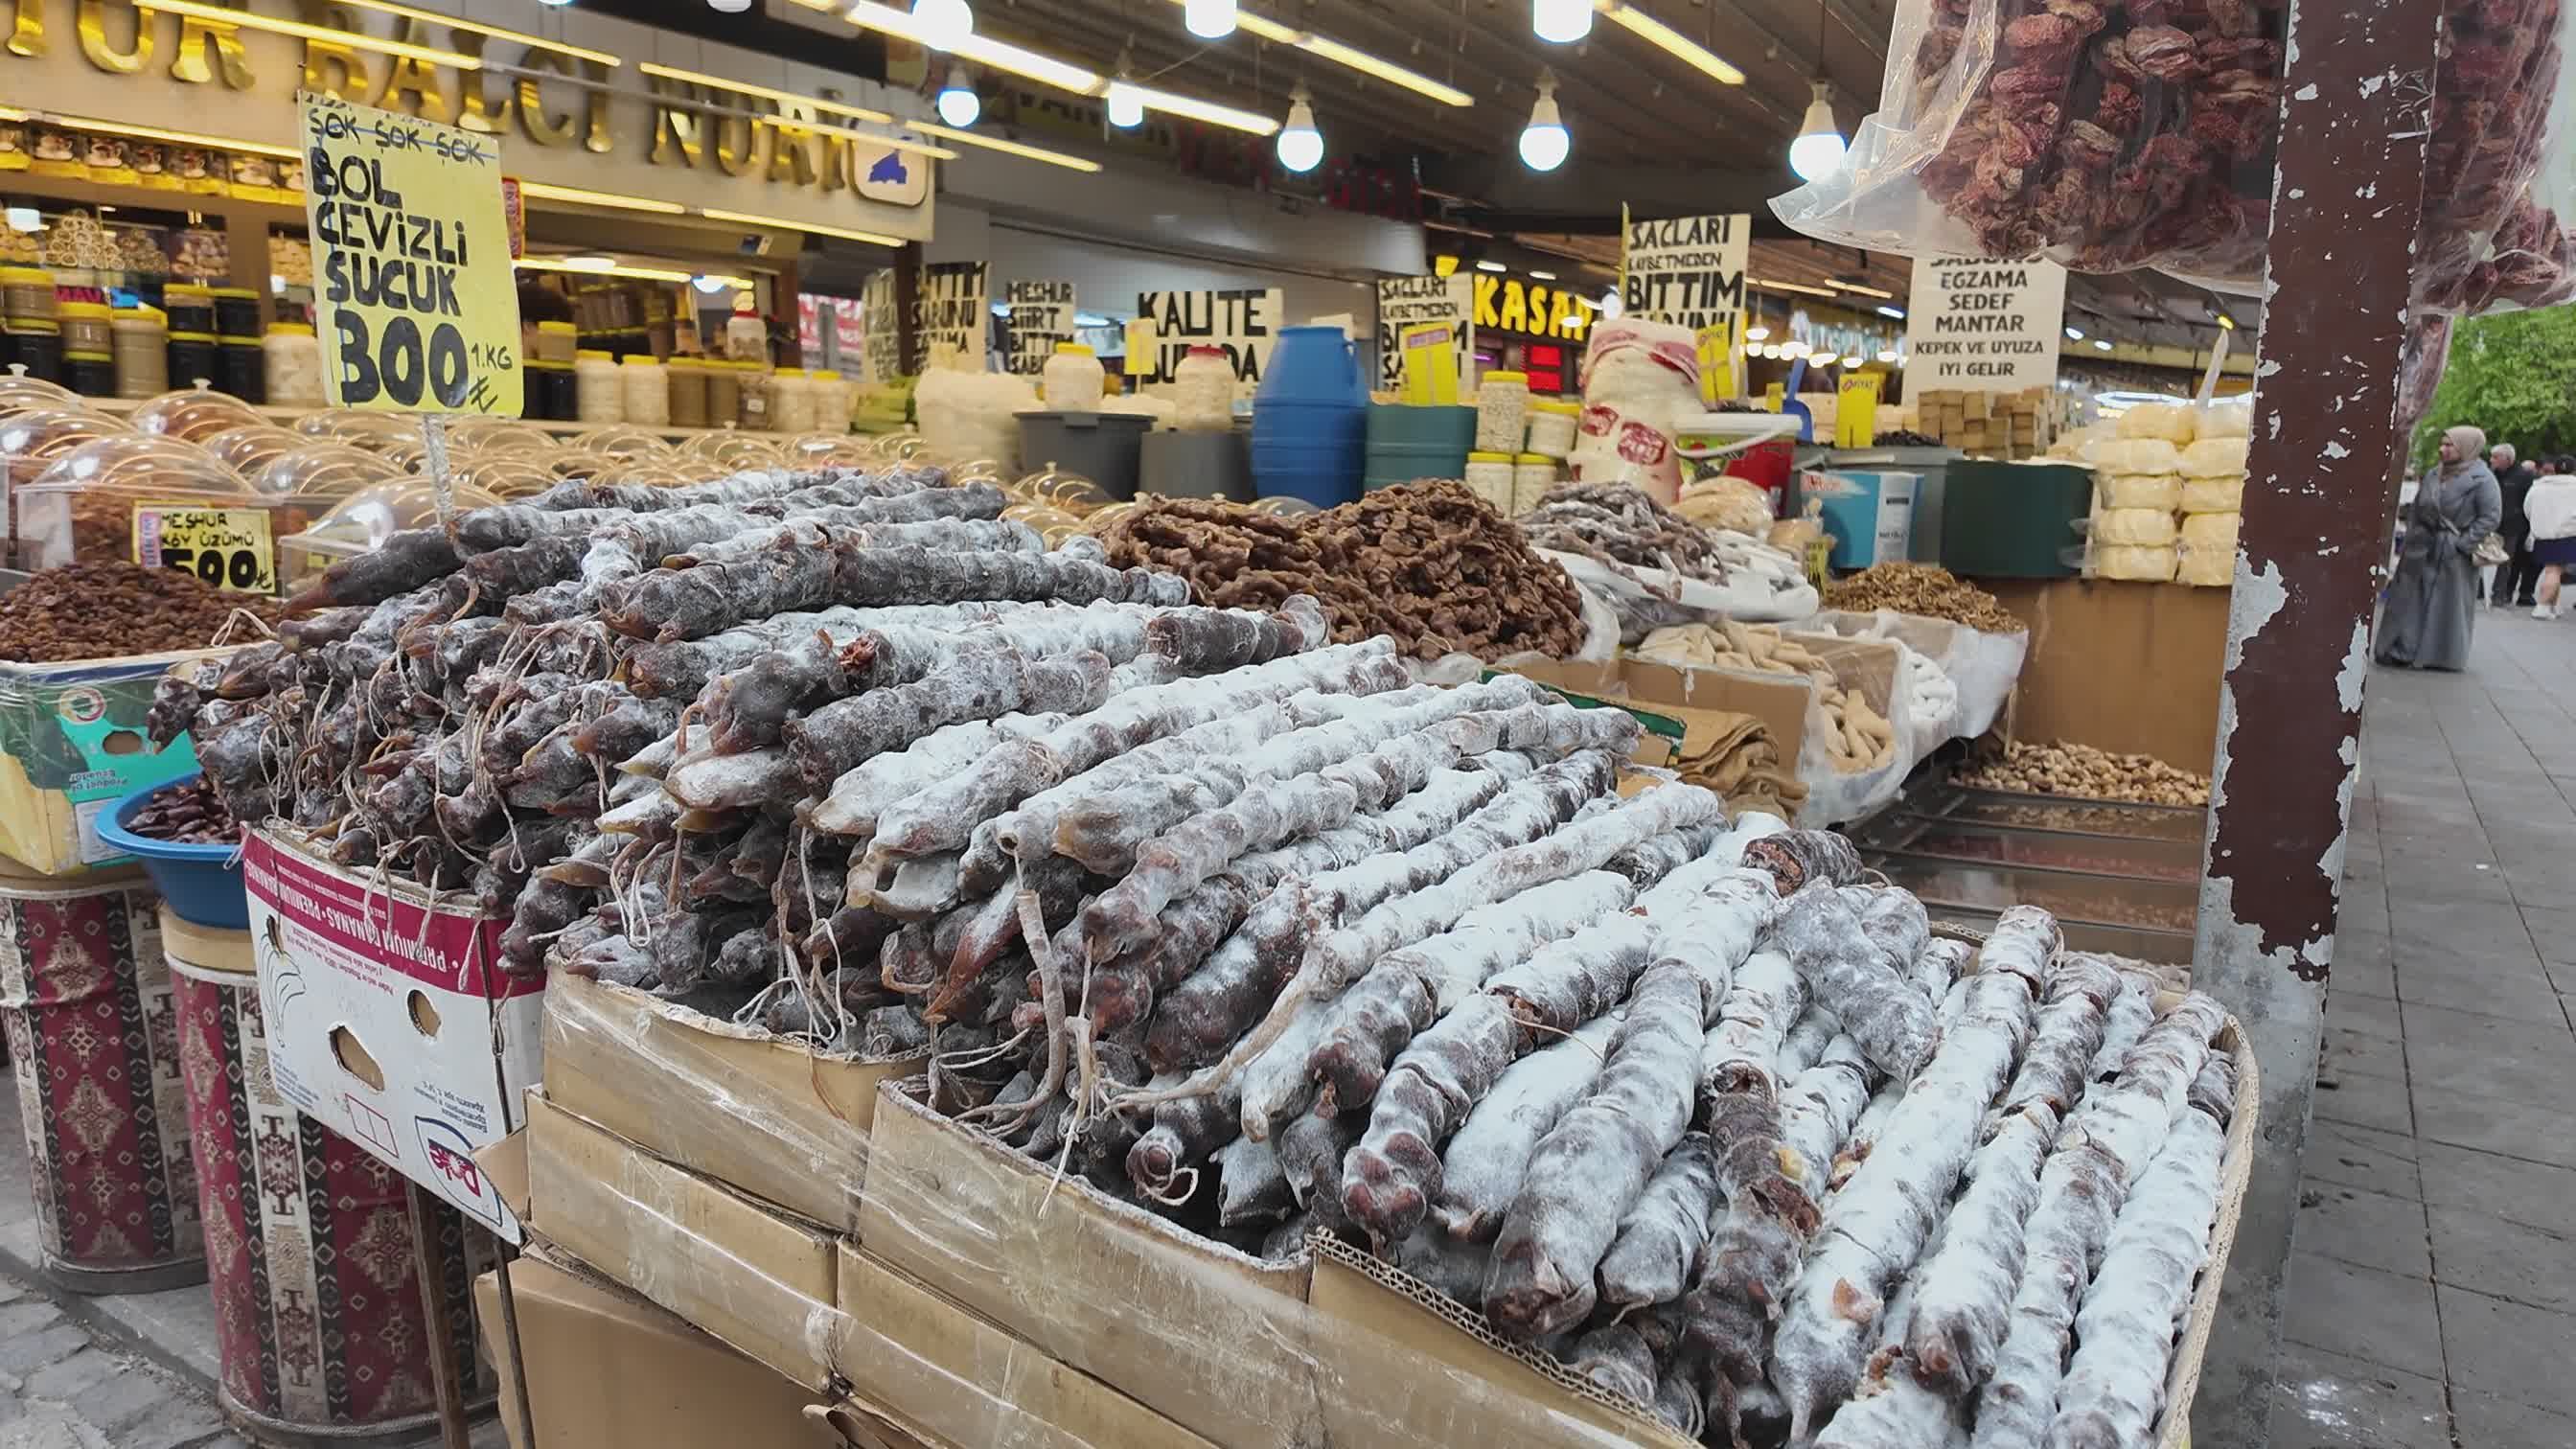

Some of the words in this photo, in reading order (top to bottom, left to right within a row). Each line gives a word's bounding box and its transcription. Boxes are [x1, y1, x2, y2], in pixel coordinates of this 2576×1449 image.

[310, 146, 402, 210] BOL
[325, 251, 462, 317] SUCUK
[1625, 270, 1744, 311] BITTIM
[1941, 269, 2028, 289] EGZAMA
[1948, 293, 2015, 310] SEDEF
[1935, 314, 2025, 334] MANTAR
[334, 309, 469, 409] 300
[1915, 341, 1964, 355] KEPEK
[1966, 341, 1987, 355] VE
[1991, 340, 2044, 355] UYUZA
[428, 1145, 482, 1198] Dole
